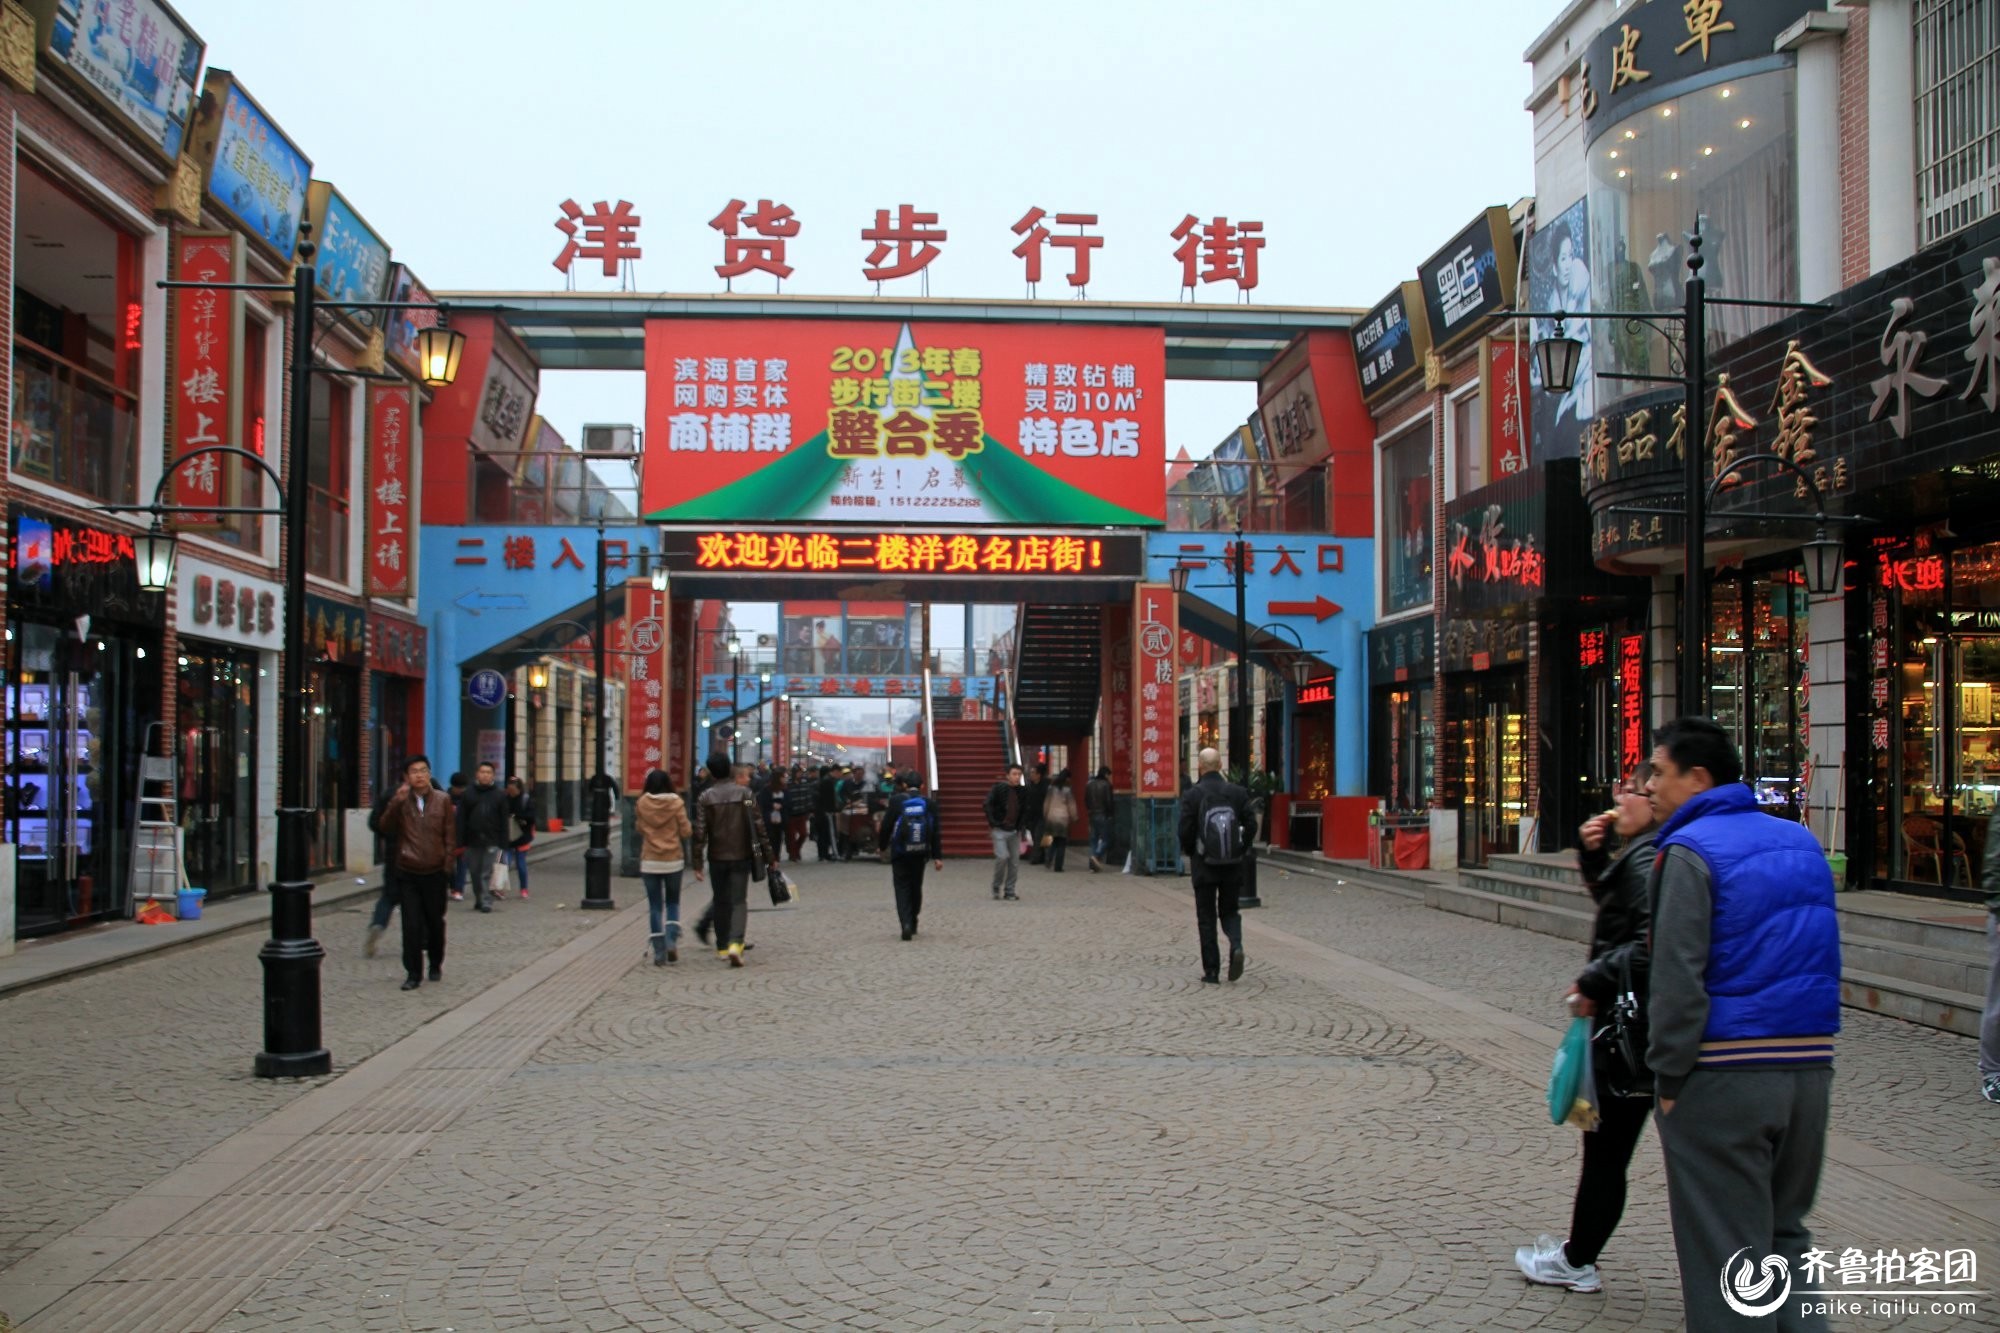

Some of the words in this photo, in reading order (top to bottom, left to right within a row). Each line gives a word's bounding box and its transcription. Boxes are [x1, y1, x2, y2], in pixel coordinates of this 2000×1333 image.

[553, 199, 1266, 289] 洋货步行街
[673, 357, 788, 382] 滨海首家
[830, 346, 982, 376] 2013年春
[1024, 362, 1136, 388] 精致钻铺
[673, 383, 788, 408] 网购实体
[830, 376, 982, 408] 步行街二楼
[826, 407, 985, 461] 整合季
[1018, 416, 1140, 457] 特色店
[454, 535, 629, 569] 二楼入口
[696, 532, 1102, 571] 欢迎光临二楼洋货名店街！
[1177, 541, 1344, 575] 二楼入口
